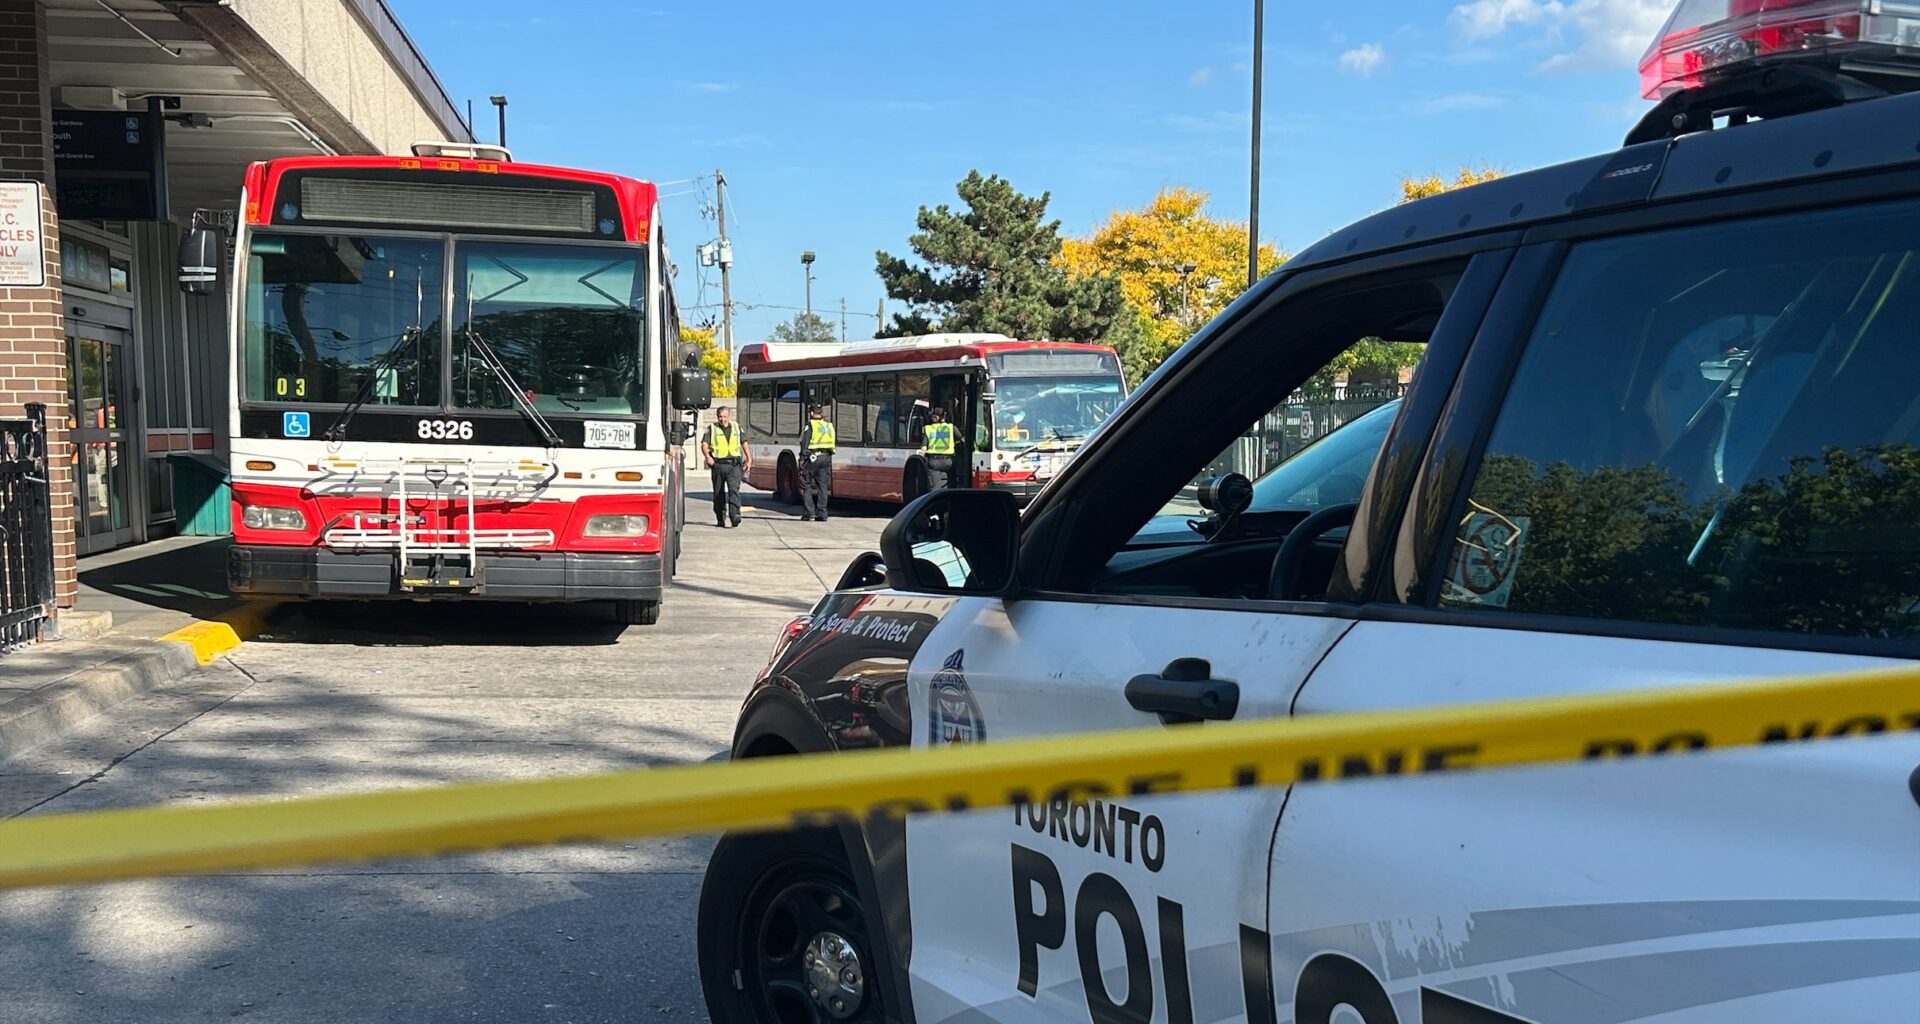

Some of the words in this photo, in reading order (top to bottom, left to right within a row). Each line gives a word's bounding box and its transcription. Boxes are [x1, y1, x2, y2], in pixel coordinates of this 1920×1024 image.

[417, 419, 474, 440] 8326
[820, 613, 856, 634] Serve
[851, 615, 870, 635] &
[862, 616, 918, 644] Protect
